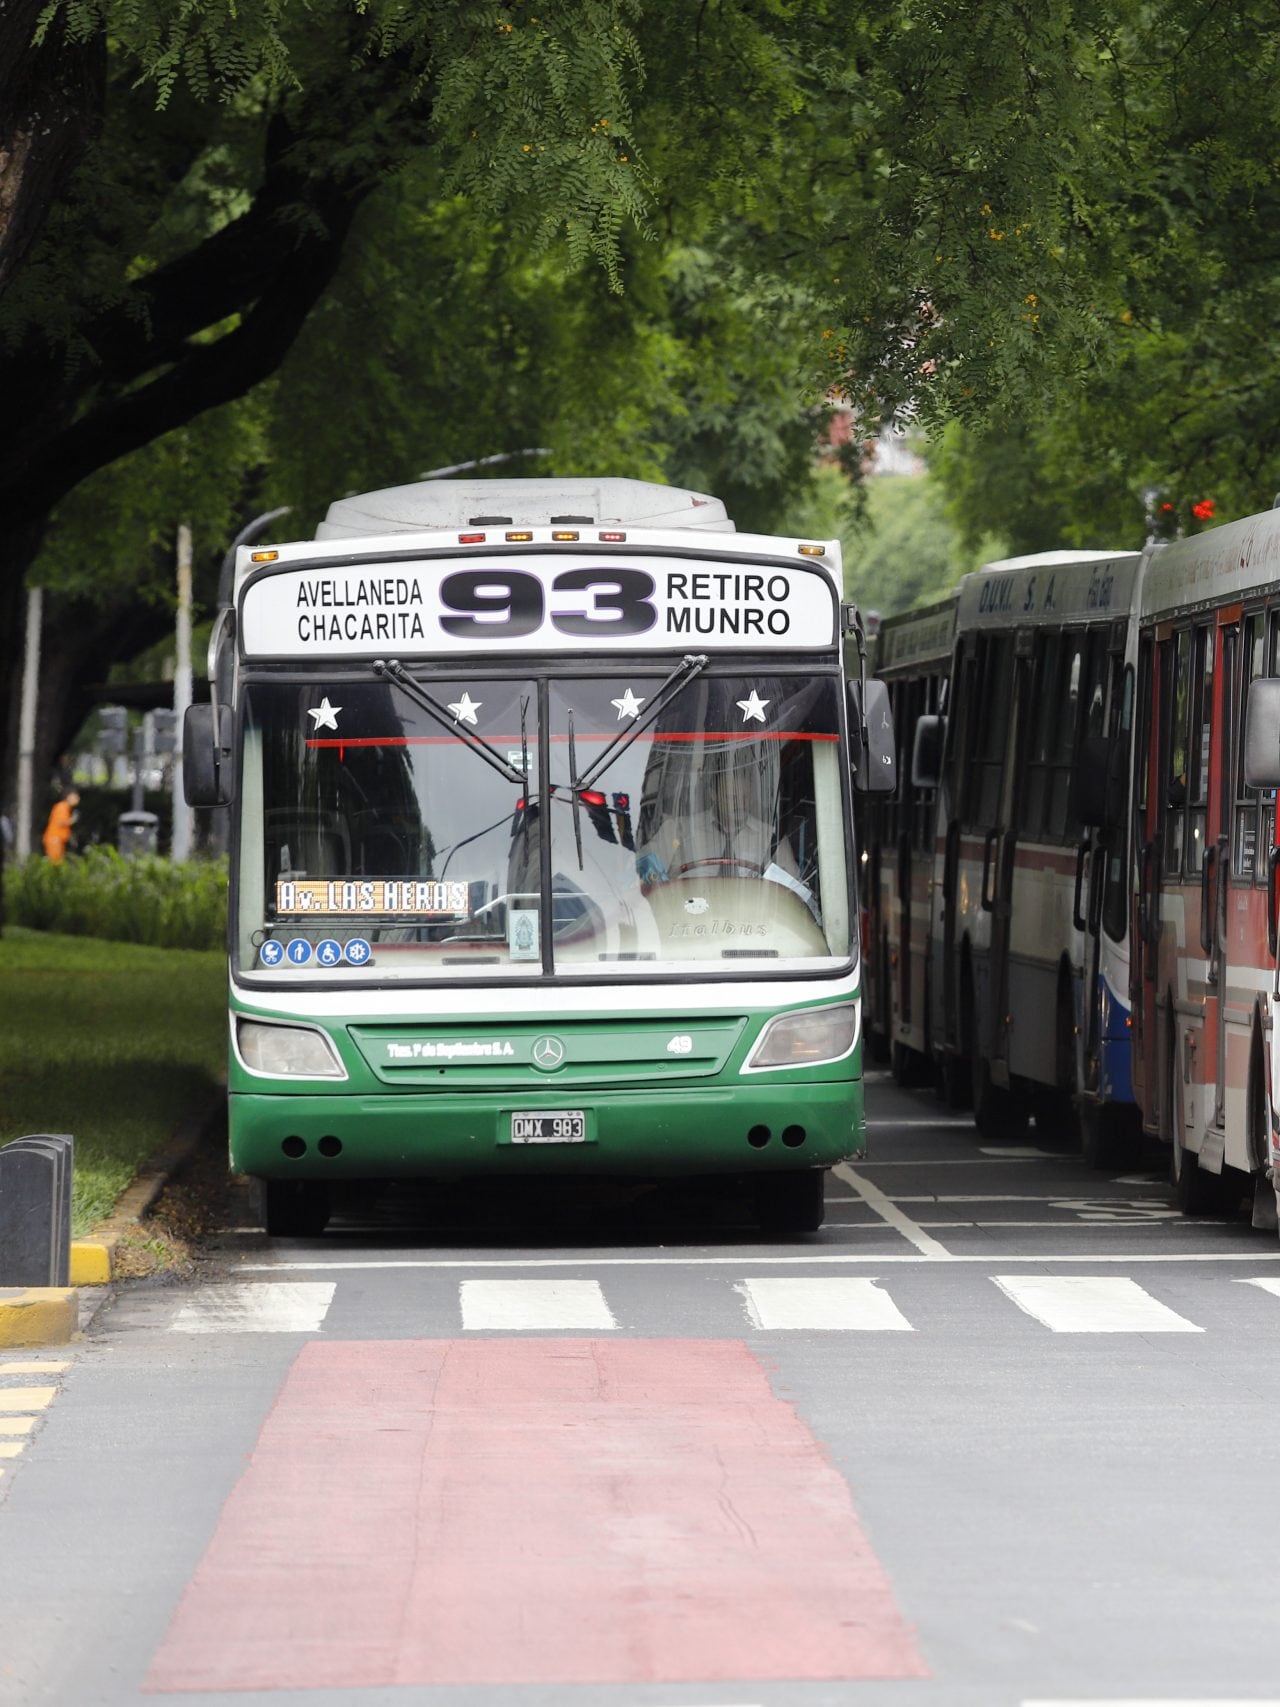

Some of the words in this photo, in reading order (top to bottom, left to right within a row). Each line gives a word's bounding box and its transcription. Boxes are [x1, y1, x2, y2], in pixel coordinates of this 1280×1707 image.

[297, 578, 423, 607] AVELLANEDA
[667, 573, 790, 602] RETIRO
[438, 567, 659, 640] 93
[298, 612, 425, 642] CHACARITA
[666, 607, 790, 635] MUNRO
[280, 882, 322, 910] Av.
[327, 882, 375, 910] LAS
[384, 881, 466, 910] HERAS
[553, 1118, 582, 1137] 983
